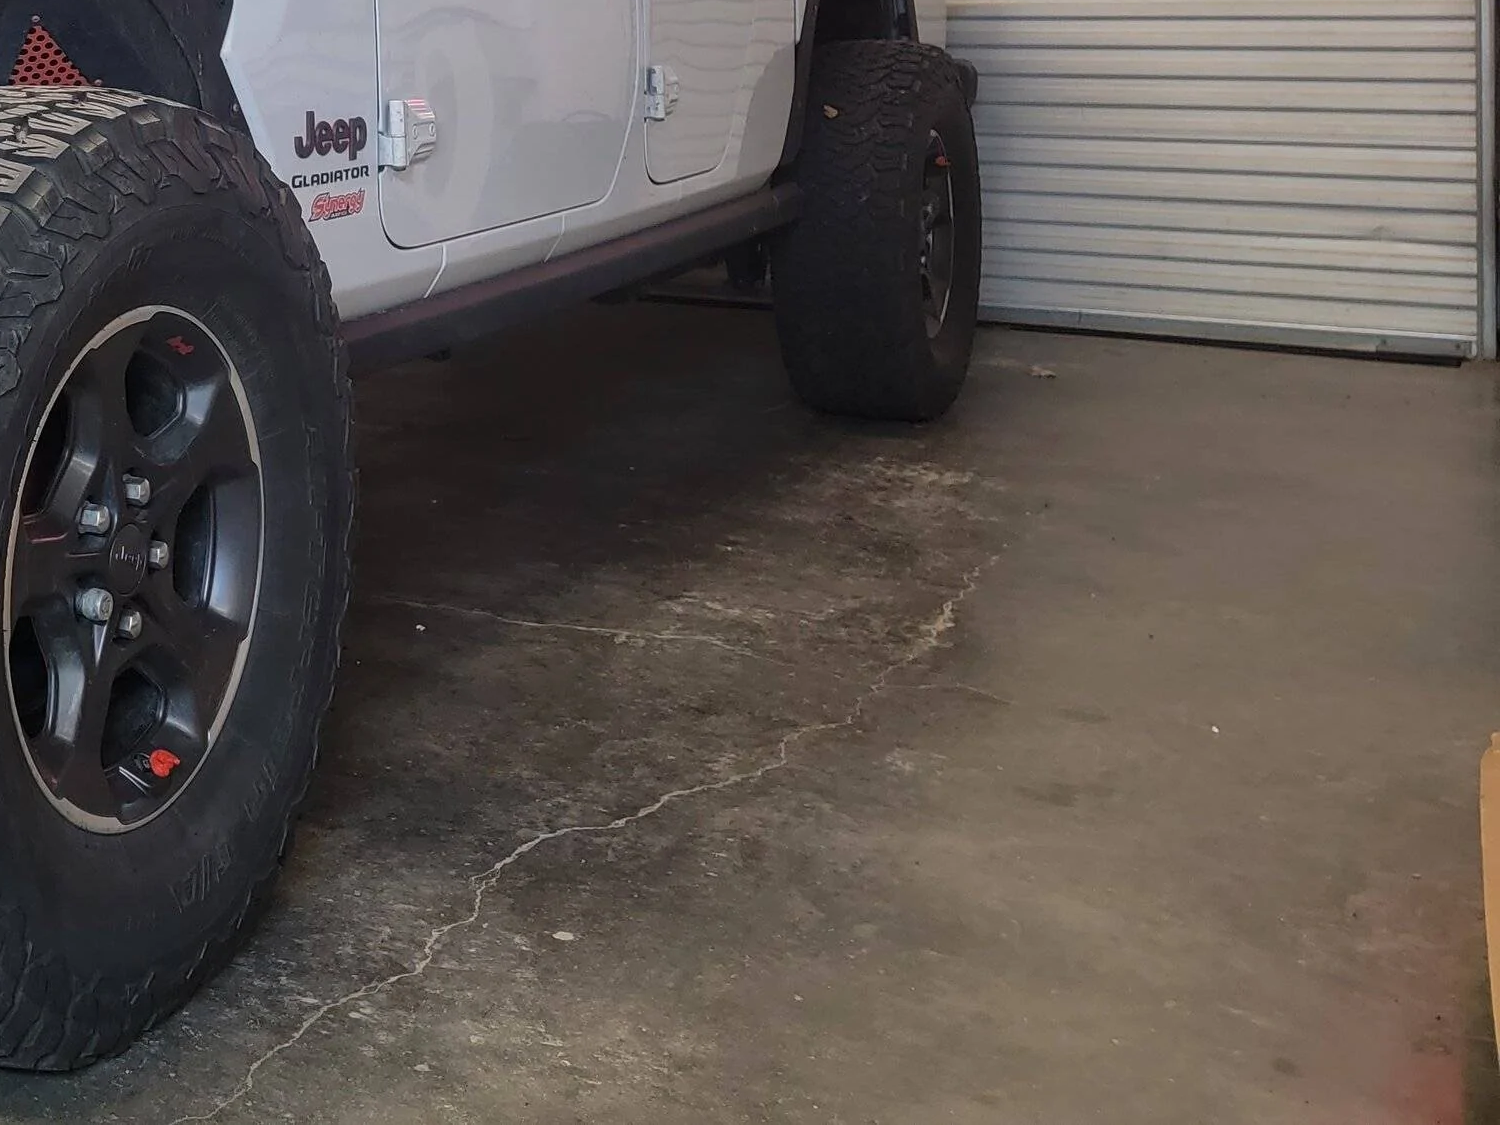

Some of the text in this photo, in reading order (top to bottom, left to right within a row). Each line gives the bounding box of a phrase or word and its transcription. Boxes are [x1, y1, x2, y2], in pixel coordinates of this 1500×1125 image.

[293, 110, 368, 162] Jeep
[291, 164, 370, 189] GLADIATOR
[308, 187, 366, 222] Synergy
